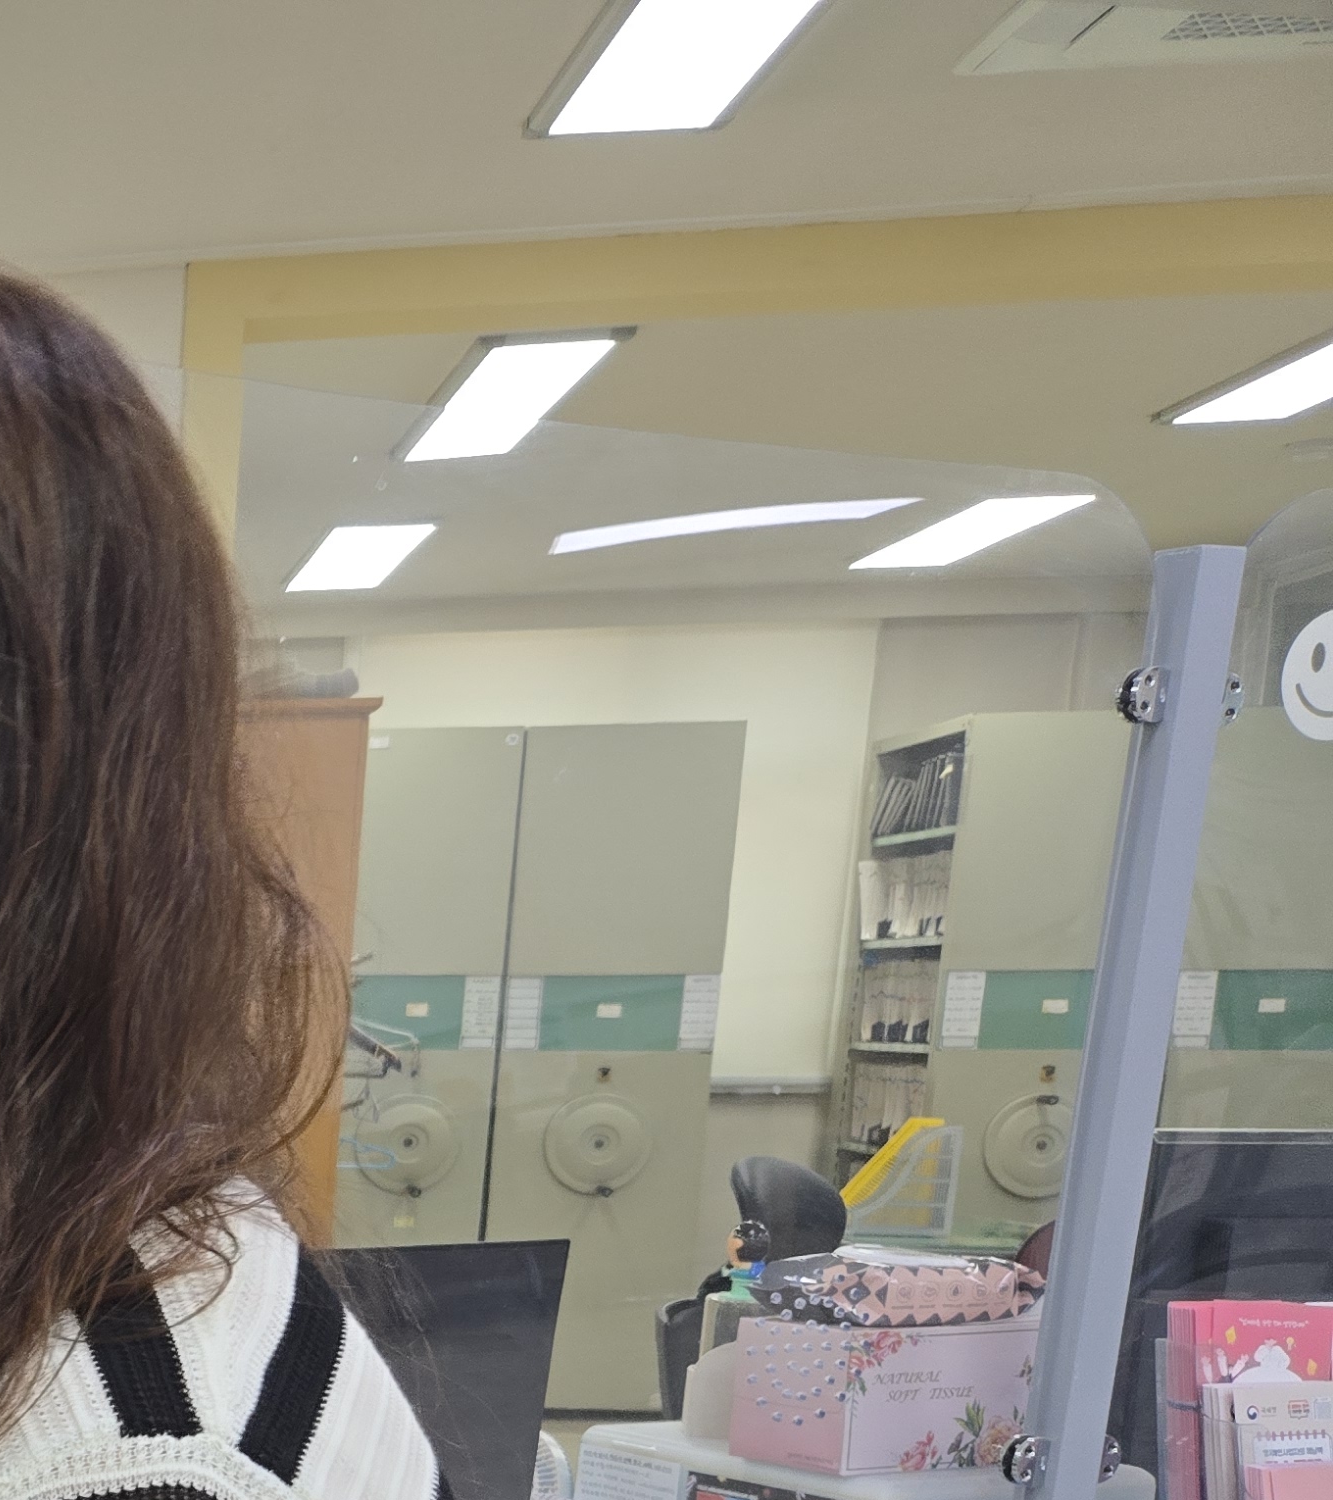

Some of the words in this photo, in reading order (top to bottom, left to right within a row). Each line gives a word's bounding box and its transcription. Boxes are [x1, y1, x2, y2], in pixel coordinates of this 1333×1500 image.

[873, 1370, 942, 1385] NATURAL
[886, 1388, 921, 1403] SOFT
[929, 1386, 974, 1400] TISSUE
